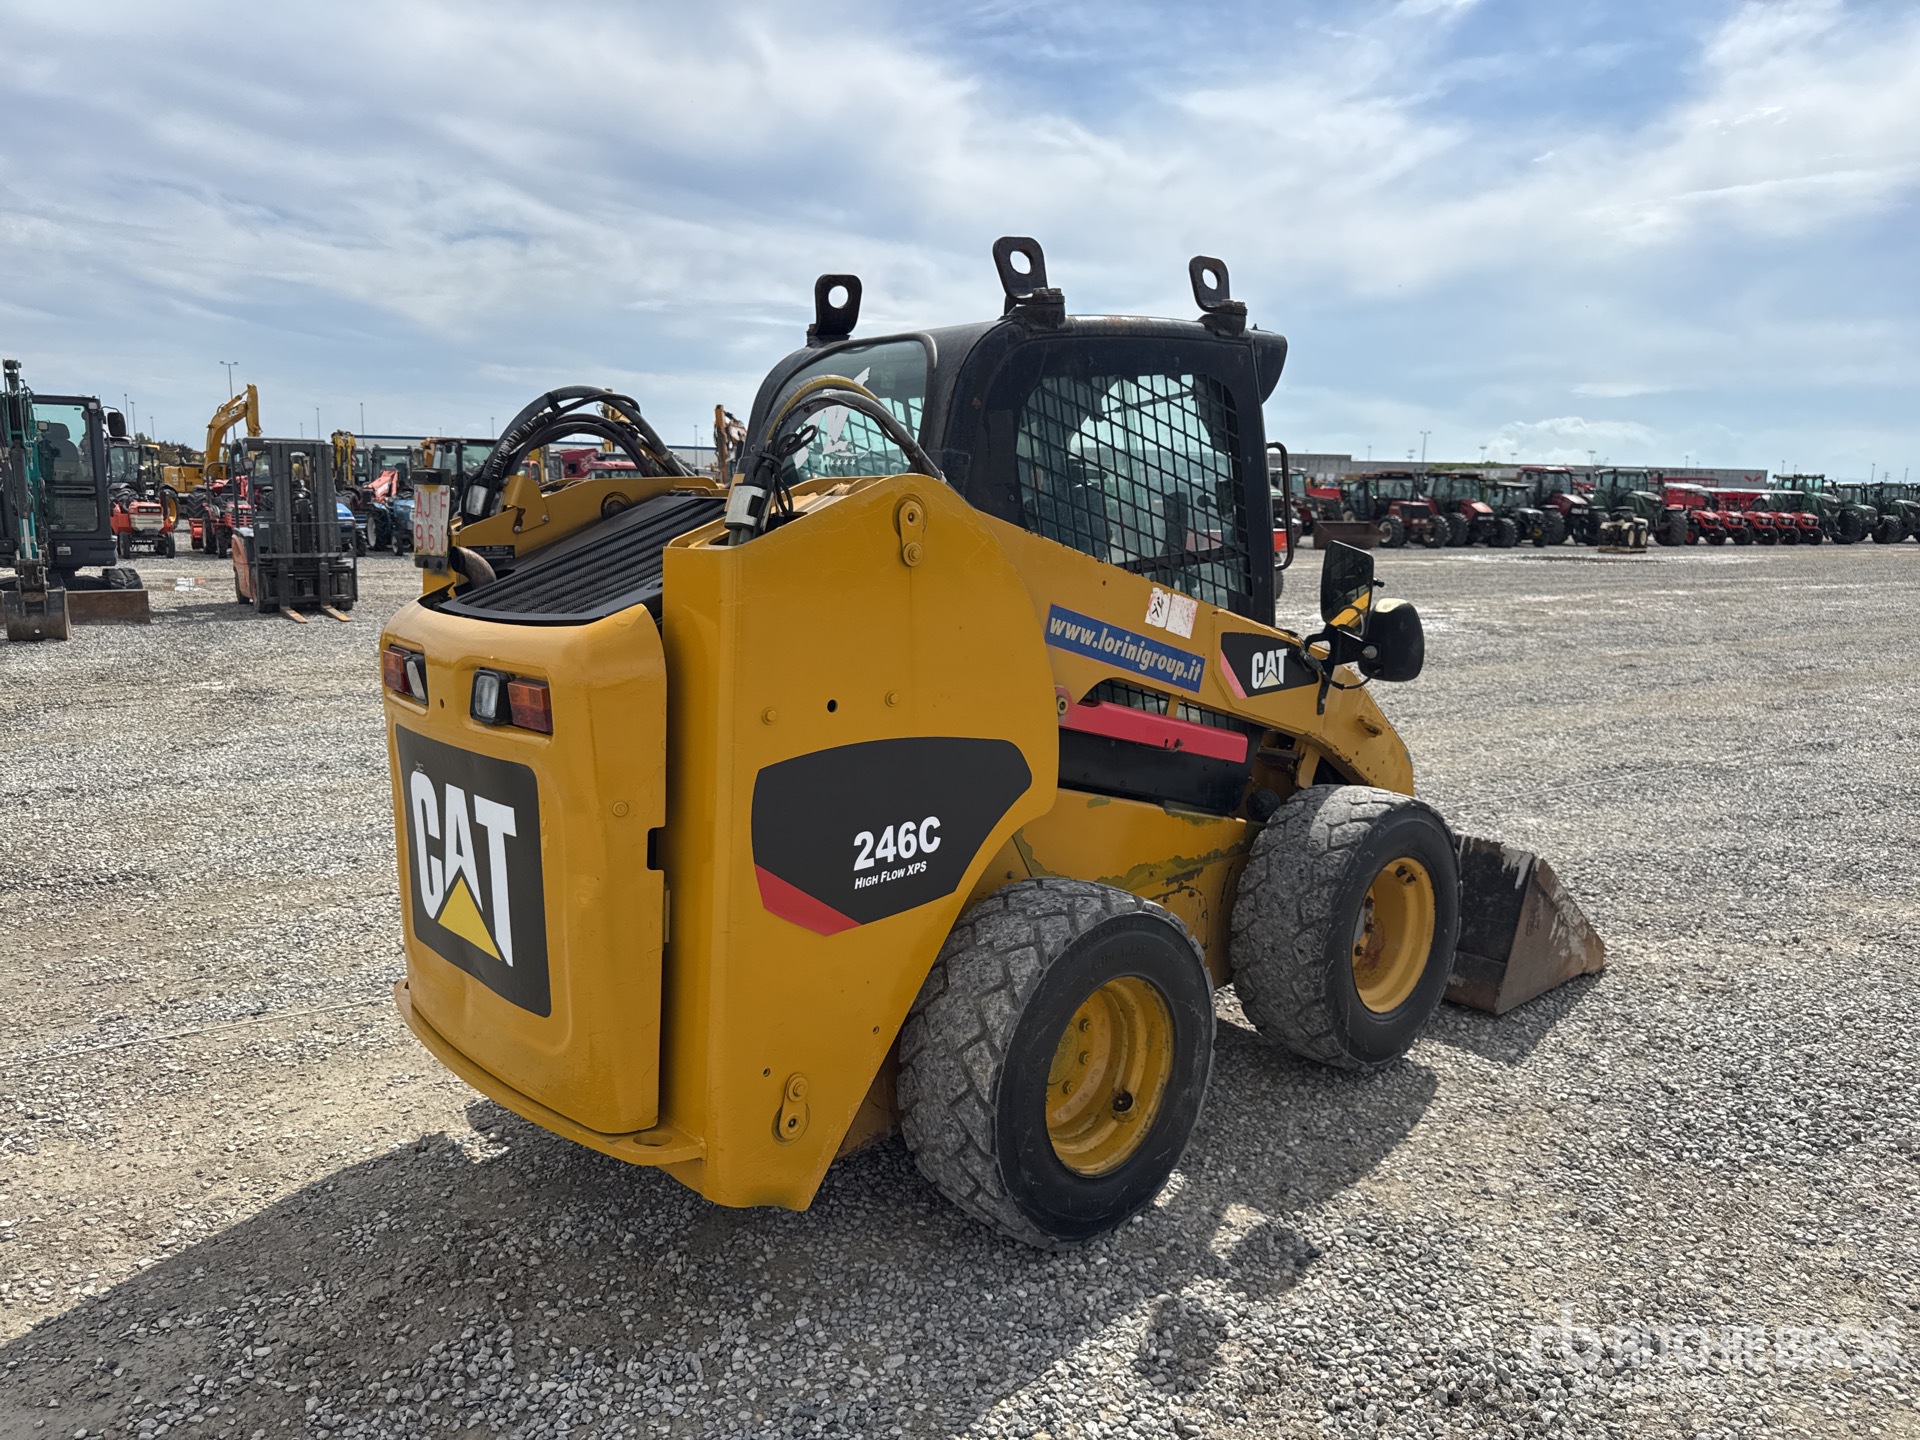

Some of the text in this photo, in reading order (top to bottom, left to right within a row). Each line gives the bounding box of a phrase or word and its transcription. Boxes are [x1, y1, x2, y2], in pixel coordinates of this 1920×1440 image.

[415, 523, 445, 552] 961
[1049, 617, 1202, 682] www.lorinigroup.it
[1251, 648, 1288, 690] CAT
[853, 815, 942, 871] 246C
[410, 769, 517, 968] CAT
[907, 860, 928, 876] XPS
